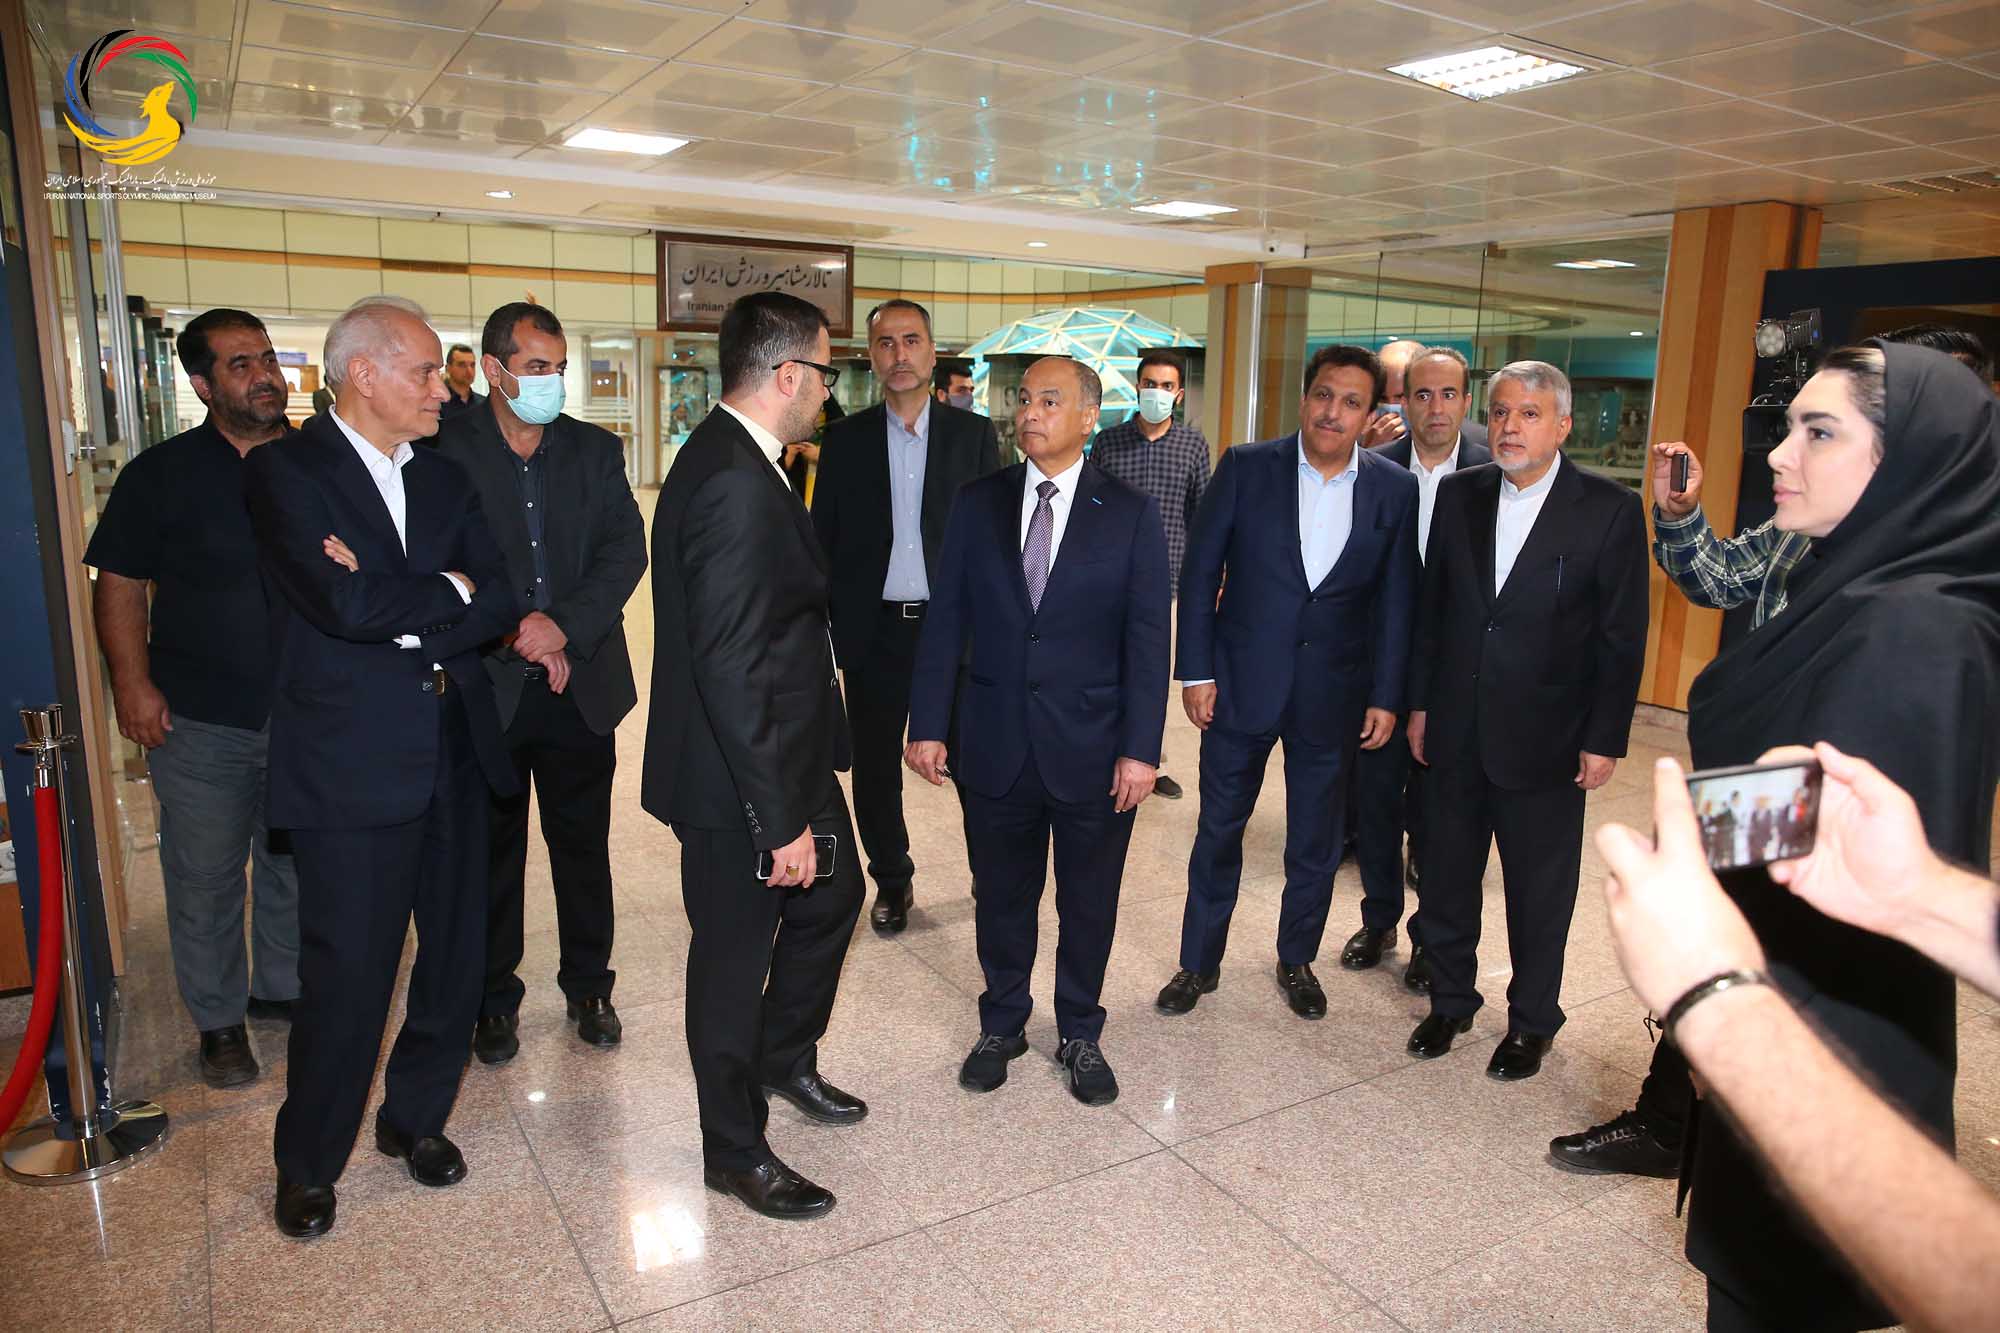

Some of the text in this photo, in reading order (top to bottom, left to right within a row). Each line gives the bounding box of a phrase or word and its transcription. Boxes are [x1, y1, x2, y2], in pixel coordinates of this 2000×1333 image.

[682, 256, 833, 291] تالار مشاهیر ورزش ایران
[687, 301, 724, 313] Iranian
